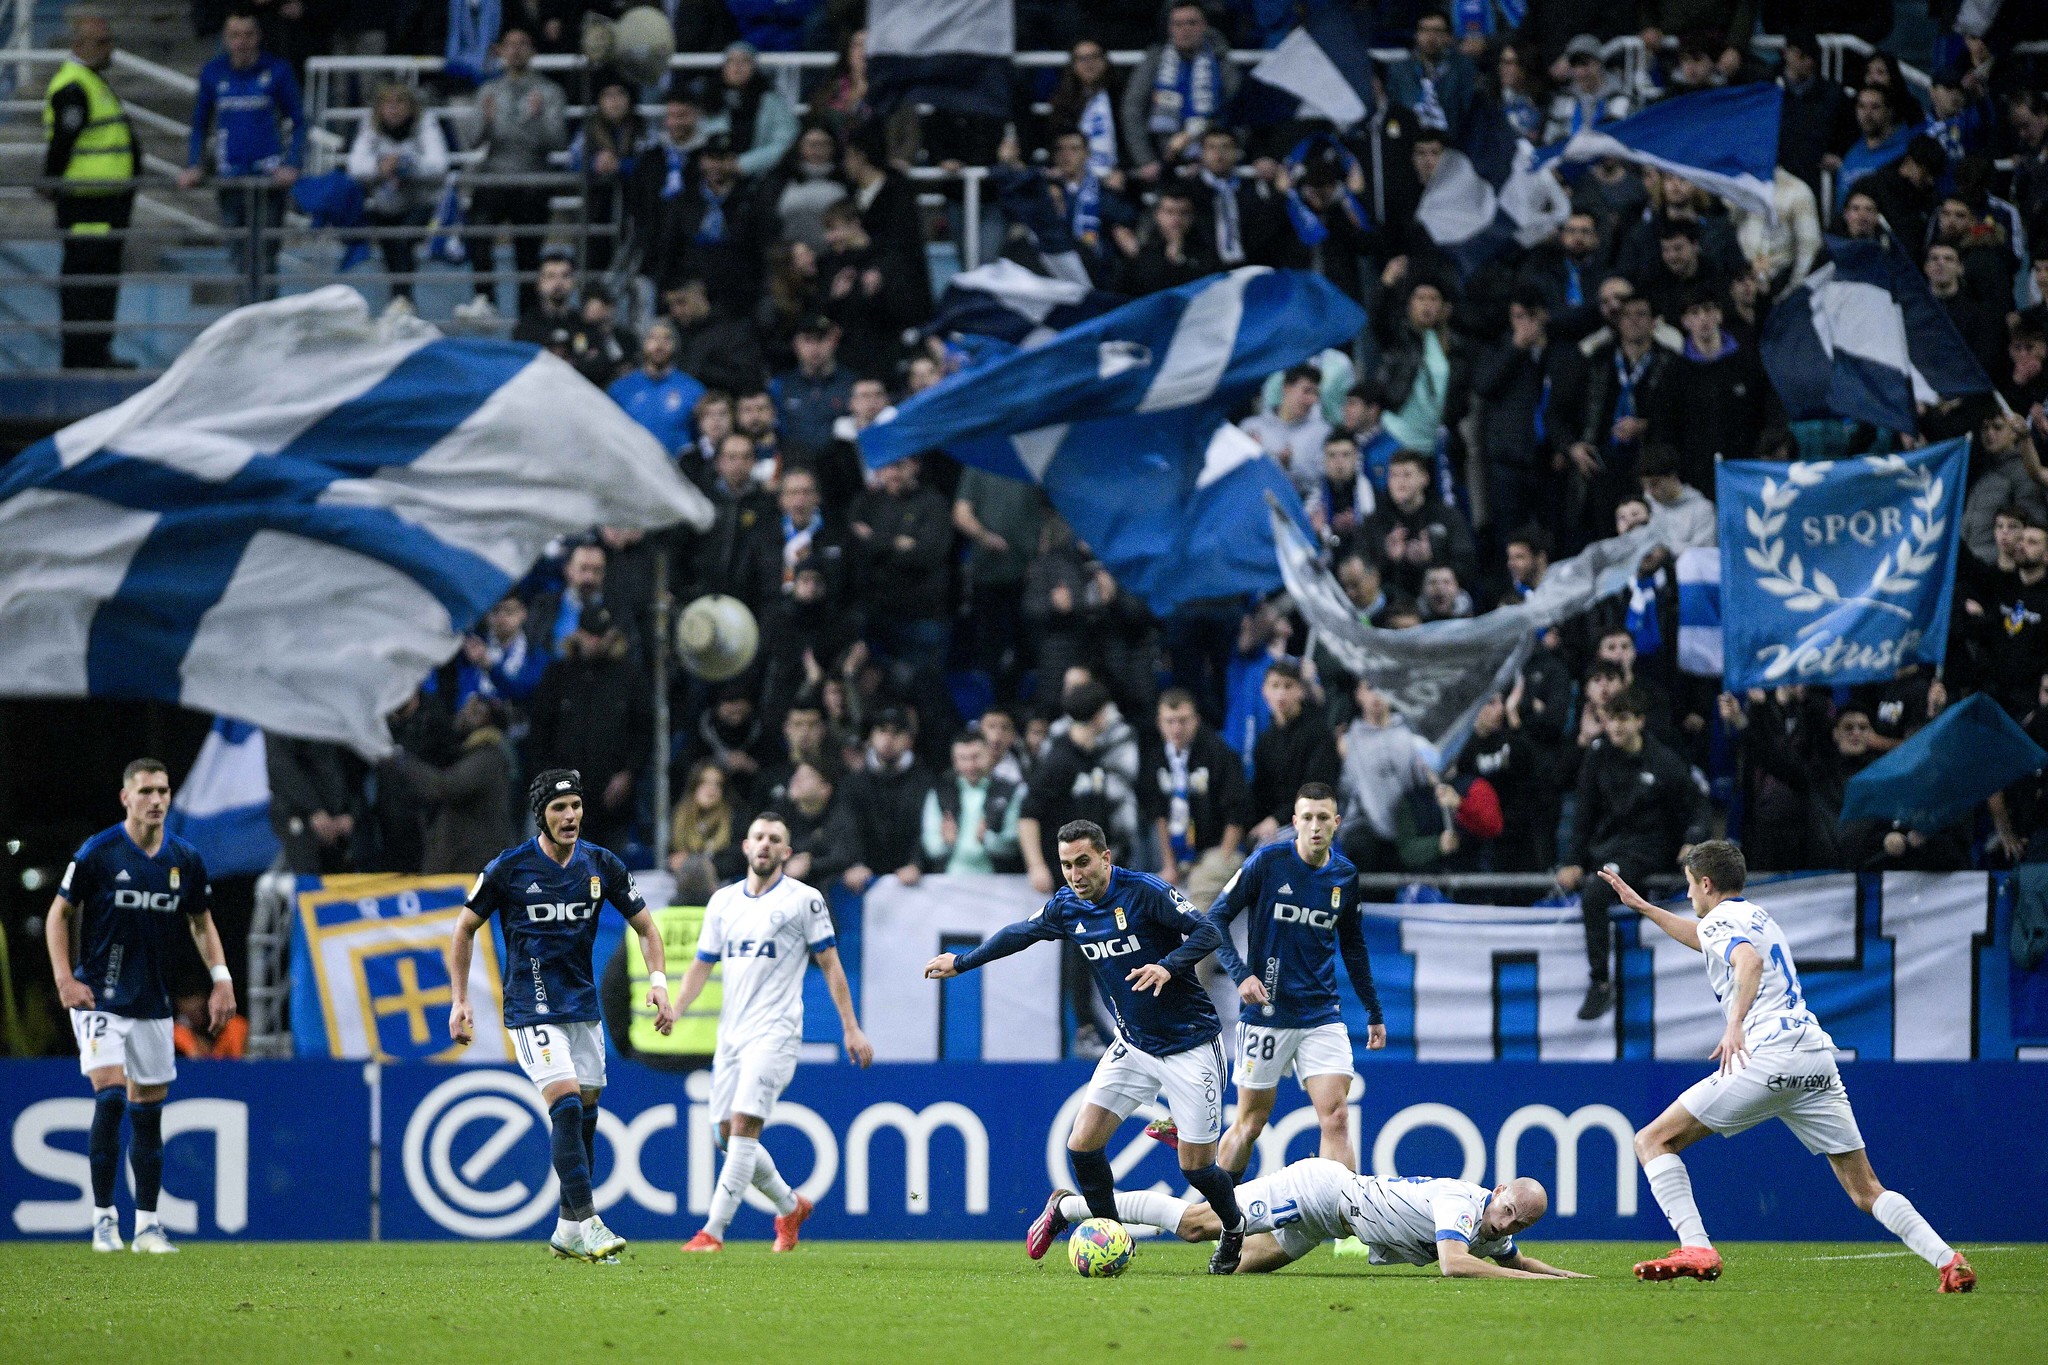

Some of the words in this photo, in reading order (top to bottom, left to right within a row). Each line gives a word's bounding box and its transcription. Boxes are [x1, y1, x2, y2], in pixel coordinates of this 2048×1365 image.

[1802, 505, 1903, 547] SPQR
[114, 889, 181, 912] DIGI
[525, 902, 598, 922] DIGI
[1273, 902, 1339, 930] DIGI
[727, 940, 777, 959] LEA
[1080, 934, 1142, 961] DIGI
[82, 1015, 108, 1039] 12
[533, 1025, 550, 1048] 5
[1246, 1033, 1276, 1061] 28
[403, 1069, 990, 1238] exiom
[1270, 1197, 1302, 1229] 18
